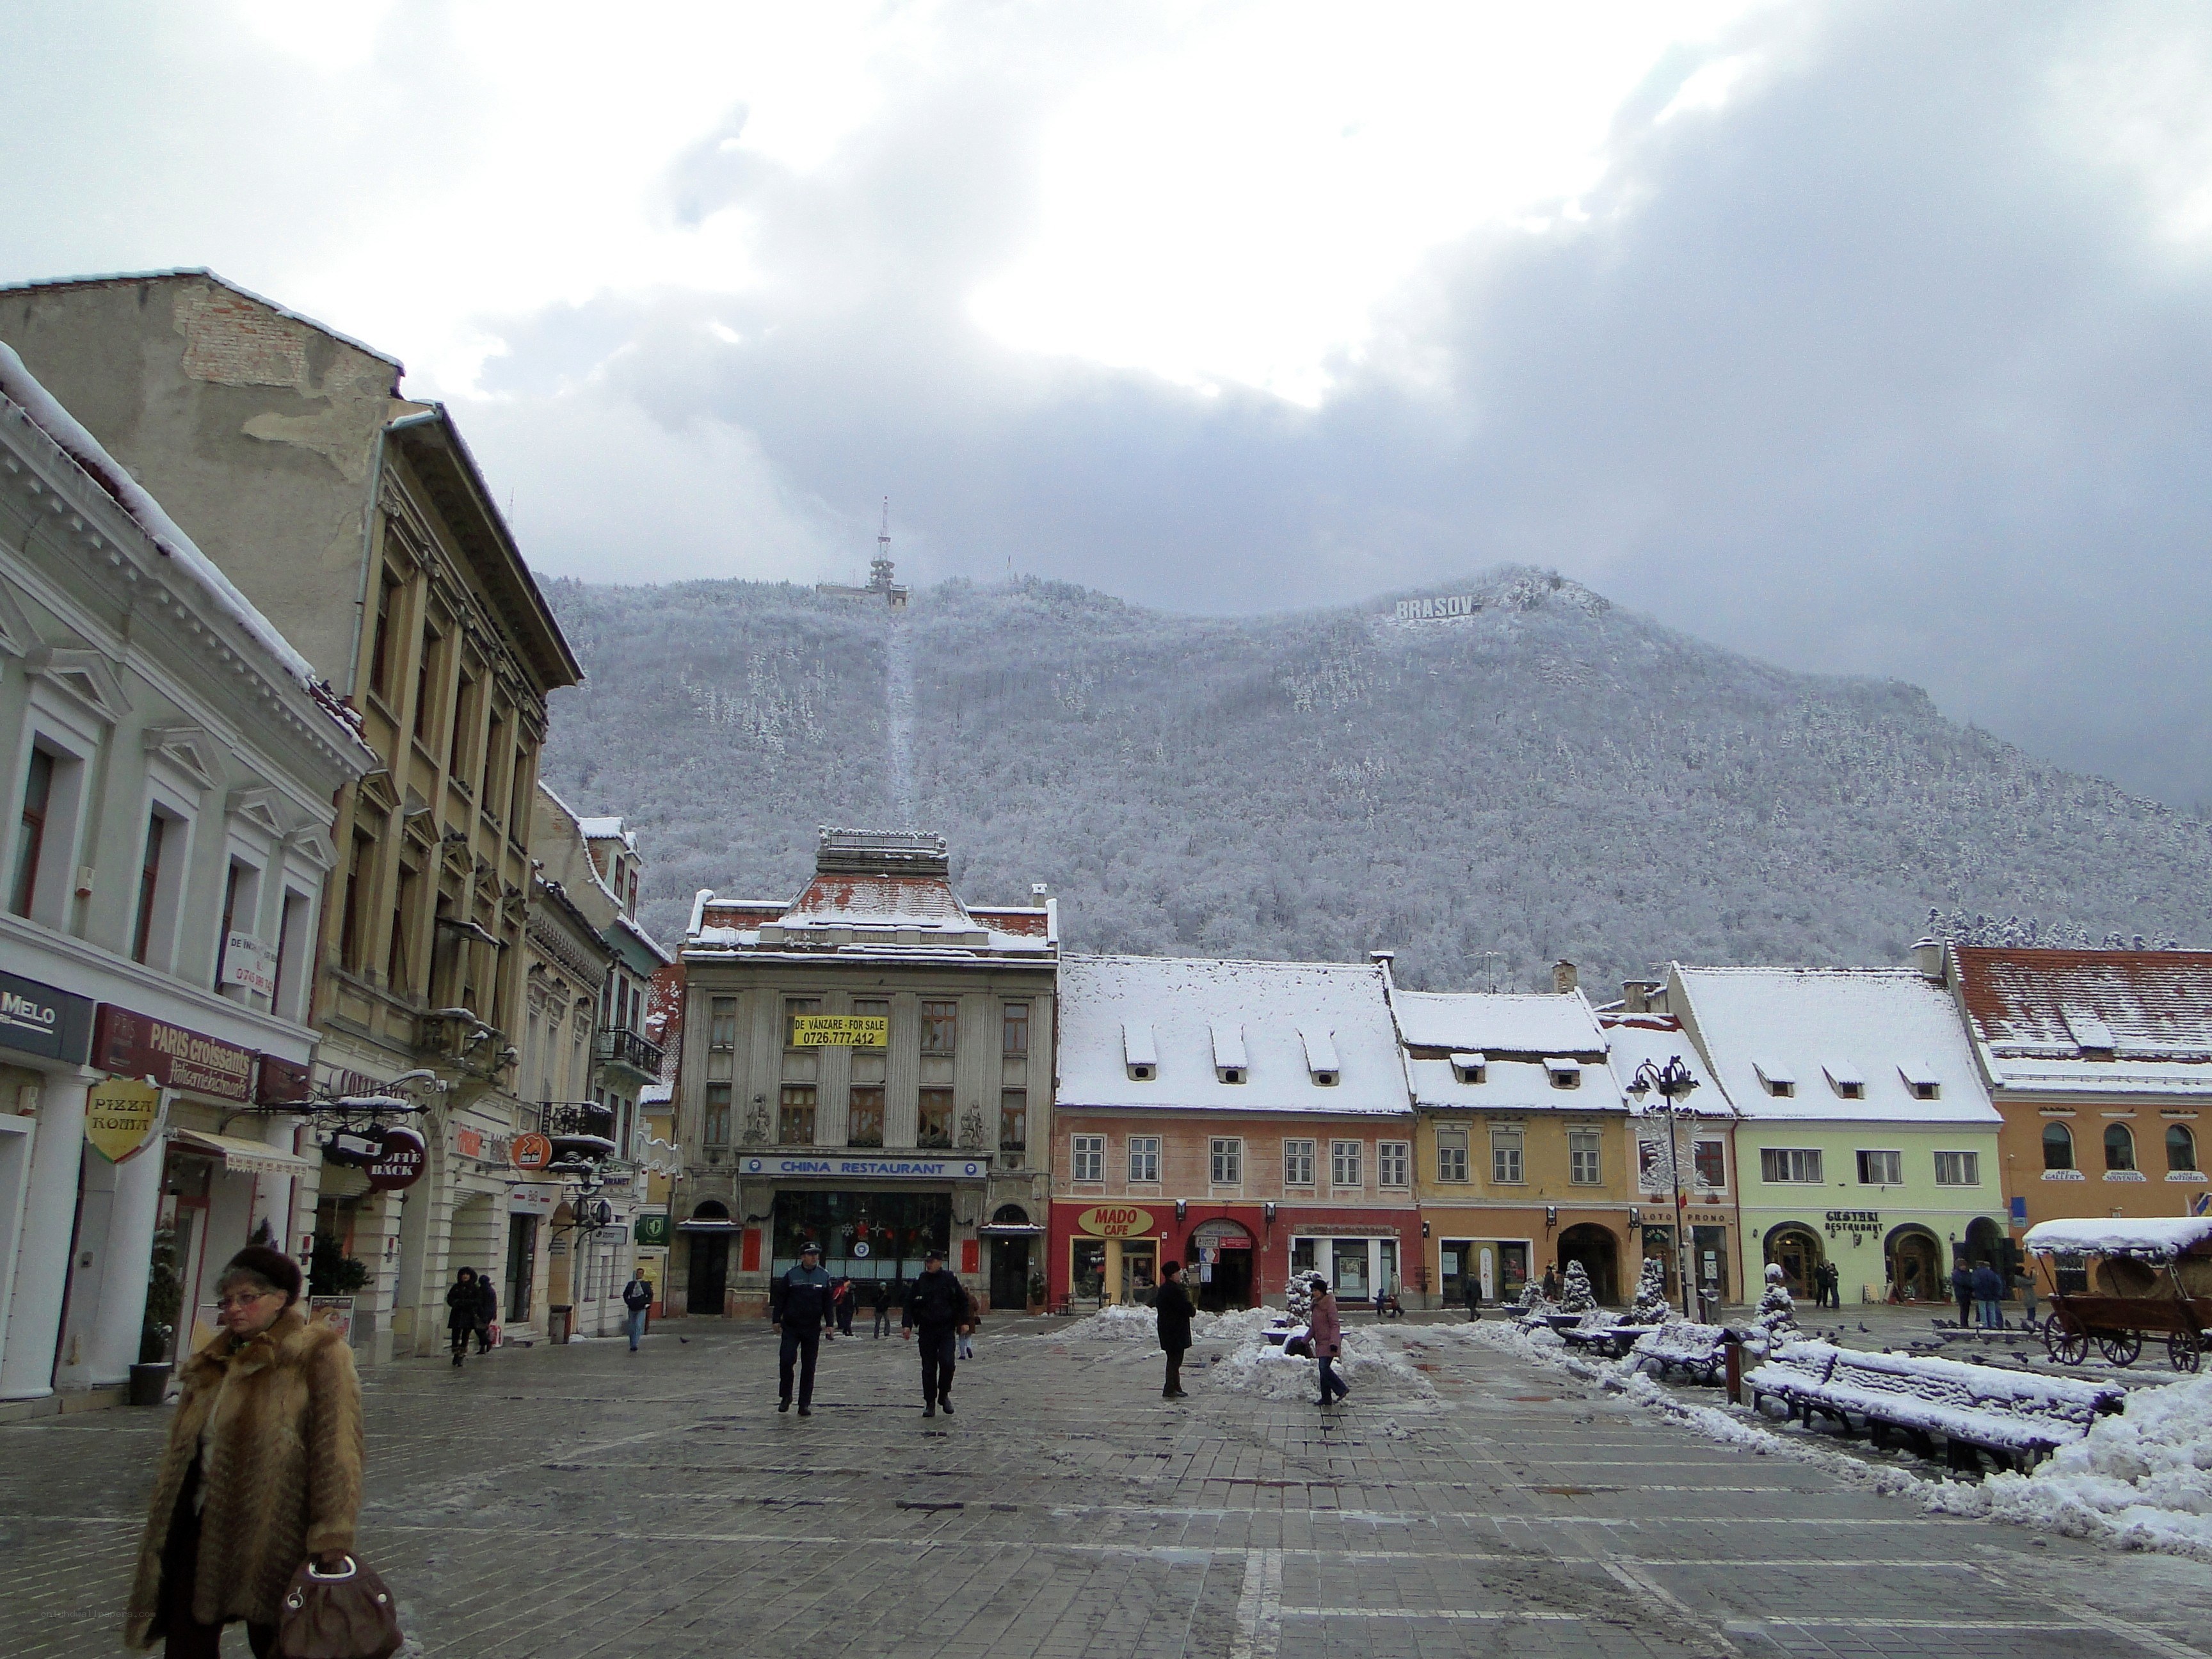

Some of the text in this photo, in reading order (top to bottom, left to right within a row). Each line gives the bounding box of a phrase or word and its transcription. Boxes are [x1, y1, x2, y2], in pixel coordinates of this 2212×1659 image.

[1396, 596, 1472, 619] BRASOV
[795, 1020, 805, 1029] DE
[849, 1020, 863, 1030] FOR
[865, 1020, 884, 1030] SALE
[803, 1032, 874, 1044] 0726.777.412
[150, 1023, 189, 1057] PARIS
[189, 1038, 250, 1075] croissants
[93, 1098, 152, 1112] PIZZA
[92, 1117, 149, 1130] ROMA
[780, 1161, 945, 1174] CHINA RESTAURANT
[1094, 1209, 1137, 1224] MADO
[1105, 1225, 1128, 1235] CAFE
[1825, 1222, 1884, 1231] RESTAURANT
